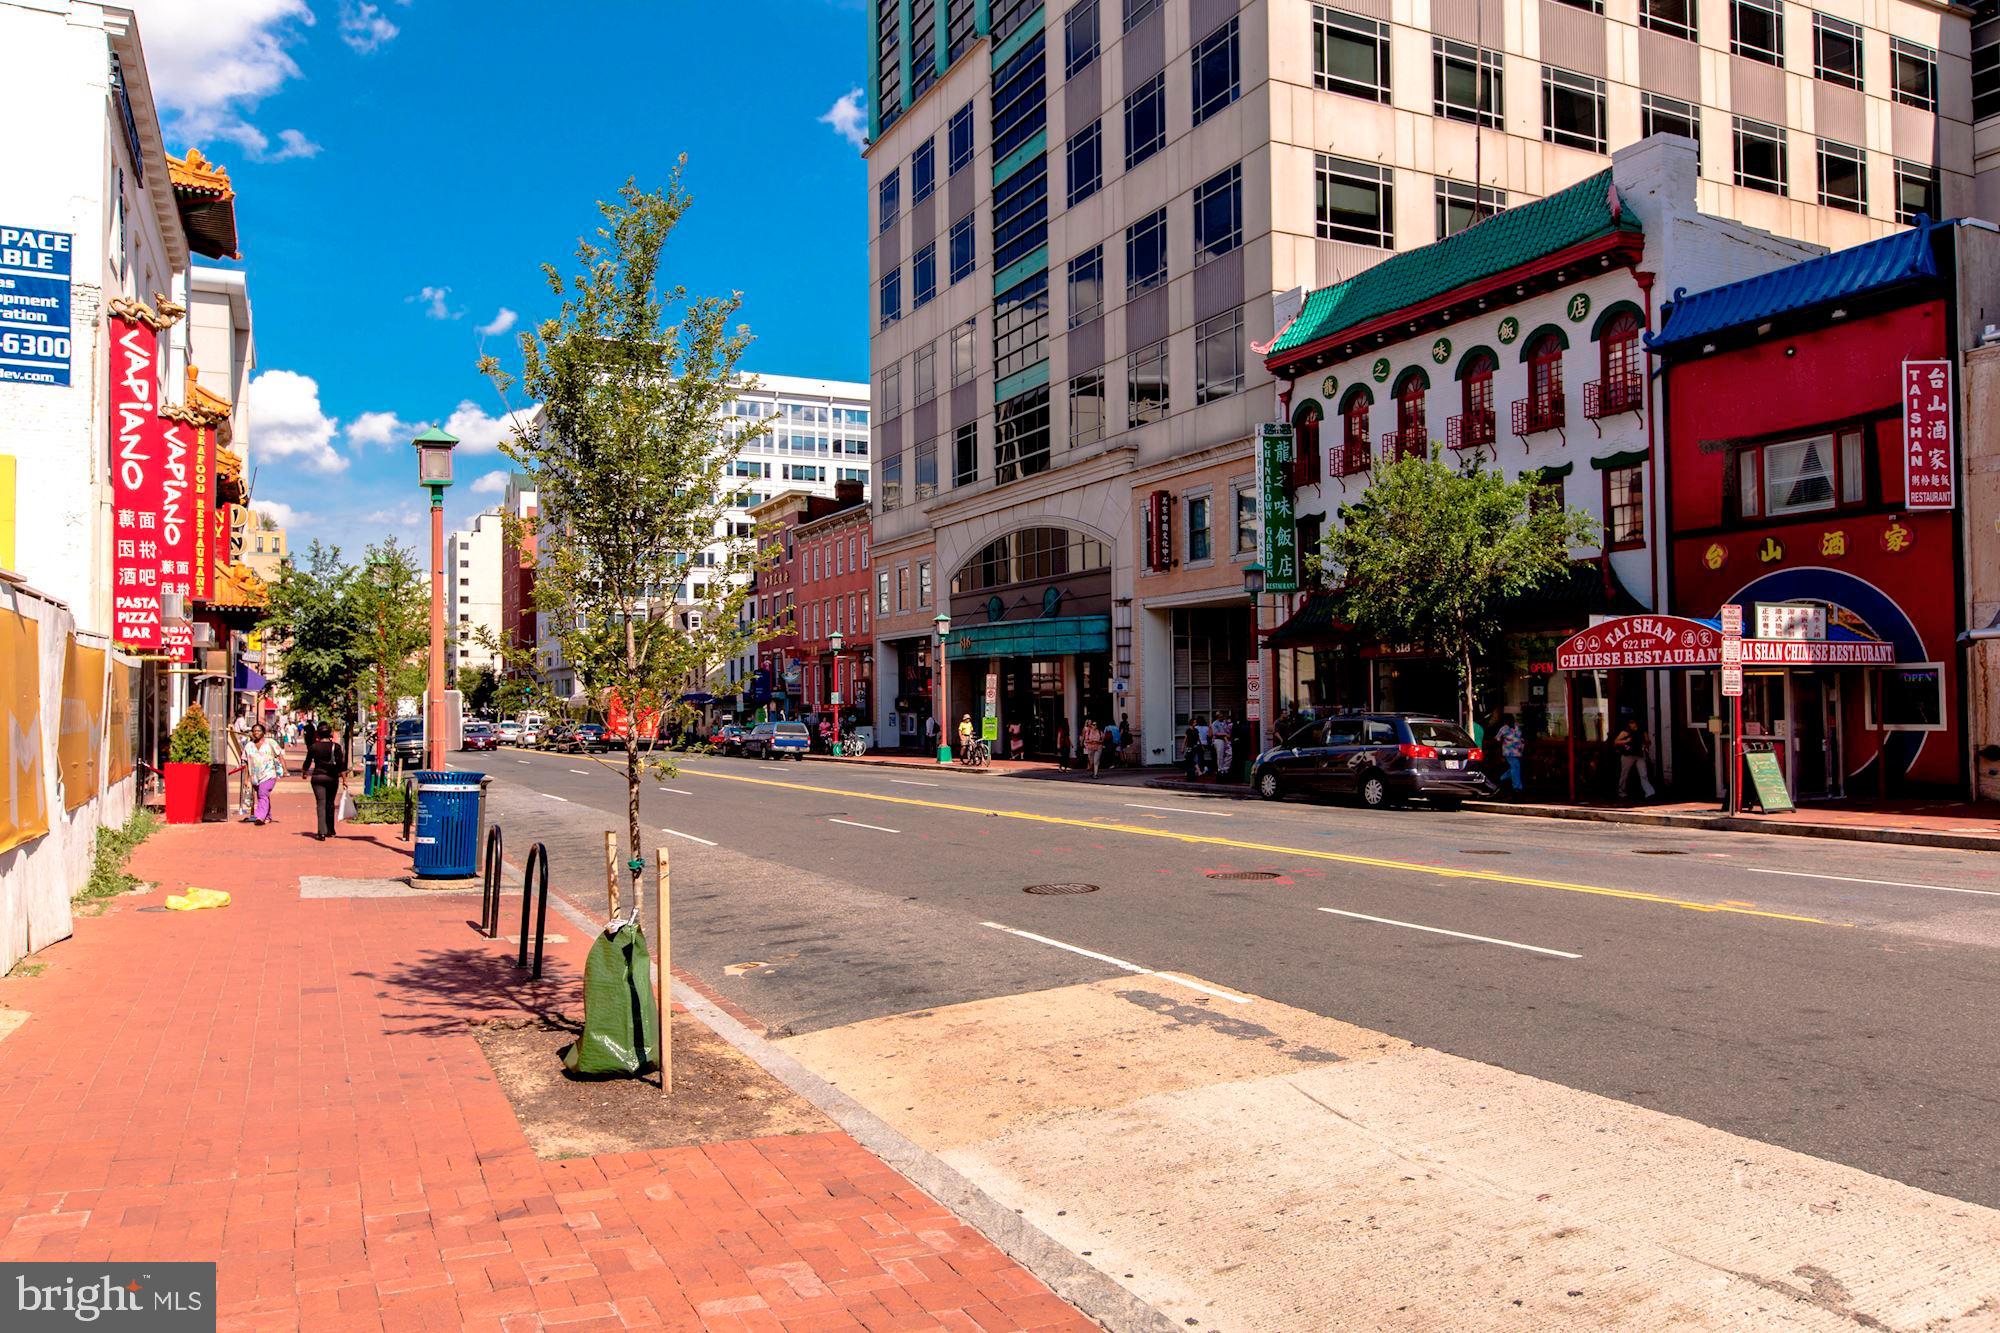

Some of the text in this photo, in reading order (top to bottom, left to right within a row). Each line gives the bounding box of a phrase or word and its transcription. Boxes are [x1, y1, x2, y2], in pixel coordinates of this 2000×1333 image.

[0, 248, 53, 269] BLE
[119, 329, 153, 490] VAPIANO
[1926, 368, 1947, 470] 台山酒家
[163, 427, 188, 546] VAPIANO
[1910, 491, 1952, 503] RESTAURANT
[1264, 441, 1274, 578] CHINATOWN GARDEN
[195, 498, 206, 597] RESTAURANT
[1704, 524, 1910, 569] 台山酒家
[117, 597, 159, 609] PASTA
[118, 612, 158, 624] PIZZA
[122, 627, 151, 638] BAR
[1604, 618, 1677, 647] TAI SHAN
[1622, 640, 1639, 649] 622
[1754, 643, 1783, 661] SHAN
[1785, 643, 1829, 661] CHINESE
[1829, 643, 1893, 662] RESTAURANT
[1531, 663, 1554, 673] OPEN
[1560, 650, 1621, 667] CHINESE
